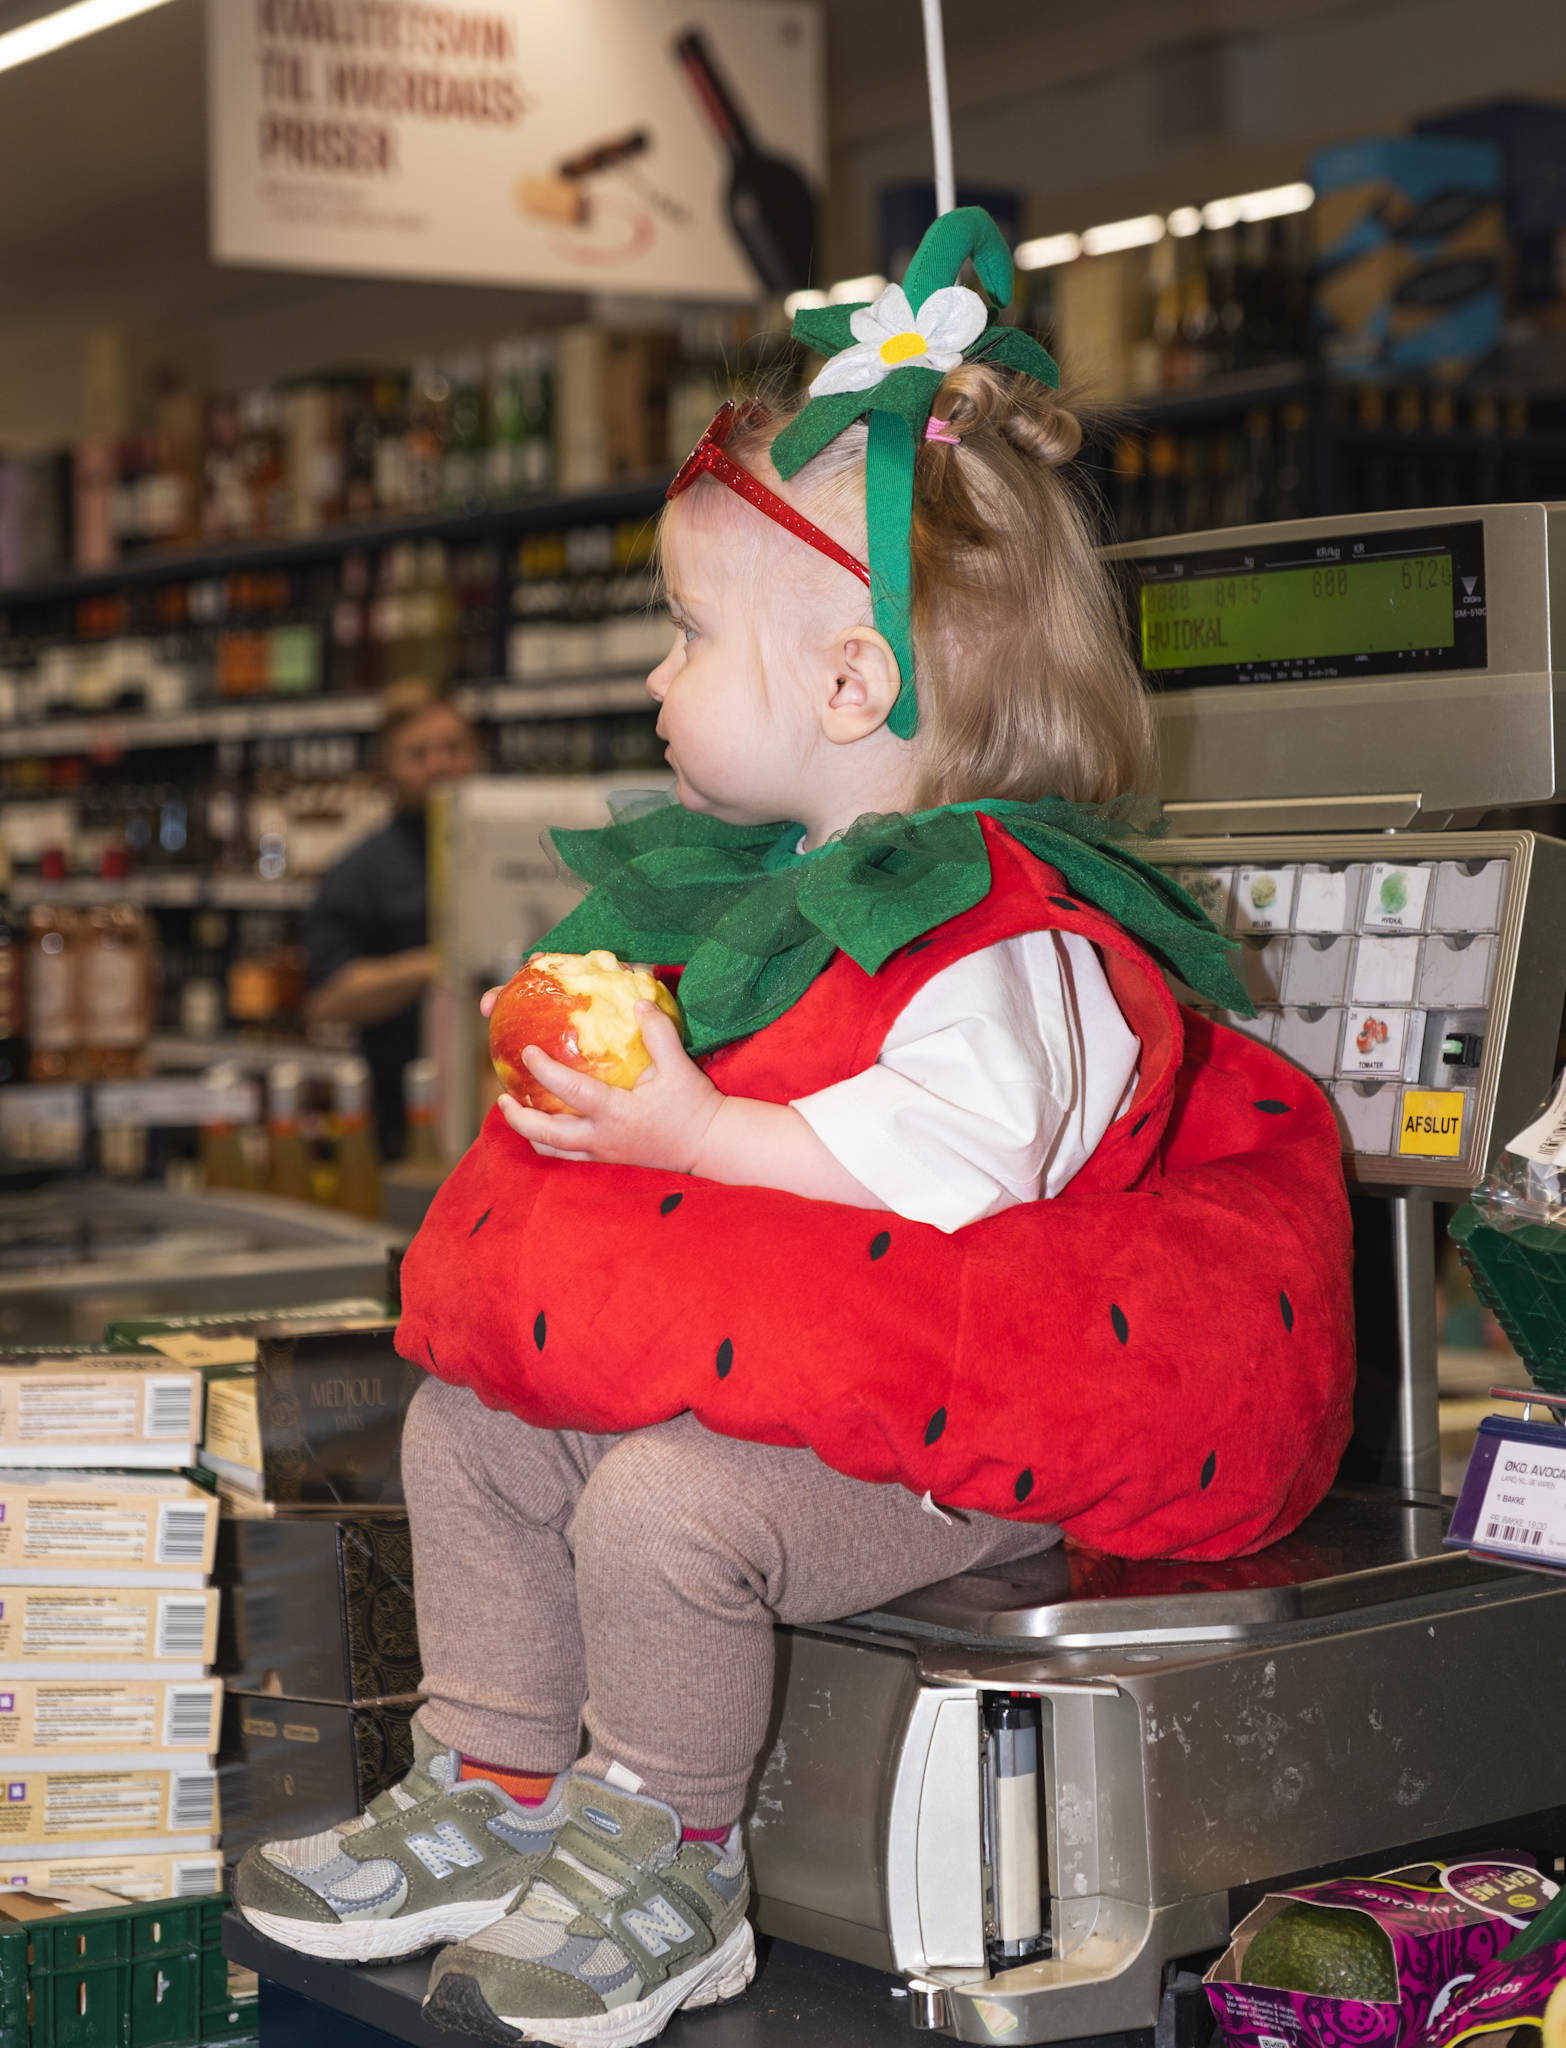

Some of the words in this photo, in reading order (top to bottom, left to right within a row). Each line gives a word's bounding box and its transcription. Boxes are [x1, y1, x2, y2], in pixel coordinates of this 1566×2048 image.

[1353, 543, 1365, 554] KR
[1358, 1061, 1384, 1069] TOMATER
[1405, 1115, 1459, 1134] AFSLUT
[1502, 1494, 1526, 1506] BAKKE
[1494, 1870, 1537, 1892] EAT
[1354, 1889, 1451, 1914] AVOCADOS
[1464, 1882, 1502, 1903] ME
[1440, 1981, 1523, 2031] AVOCADOS
